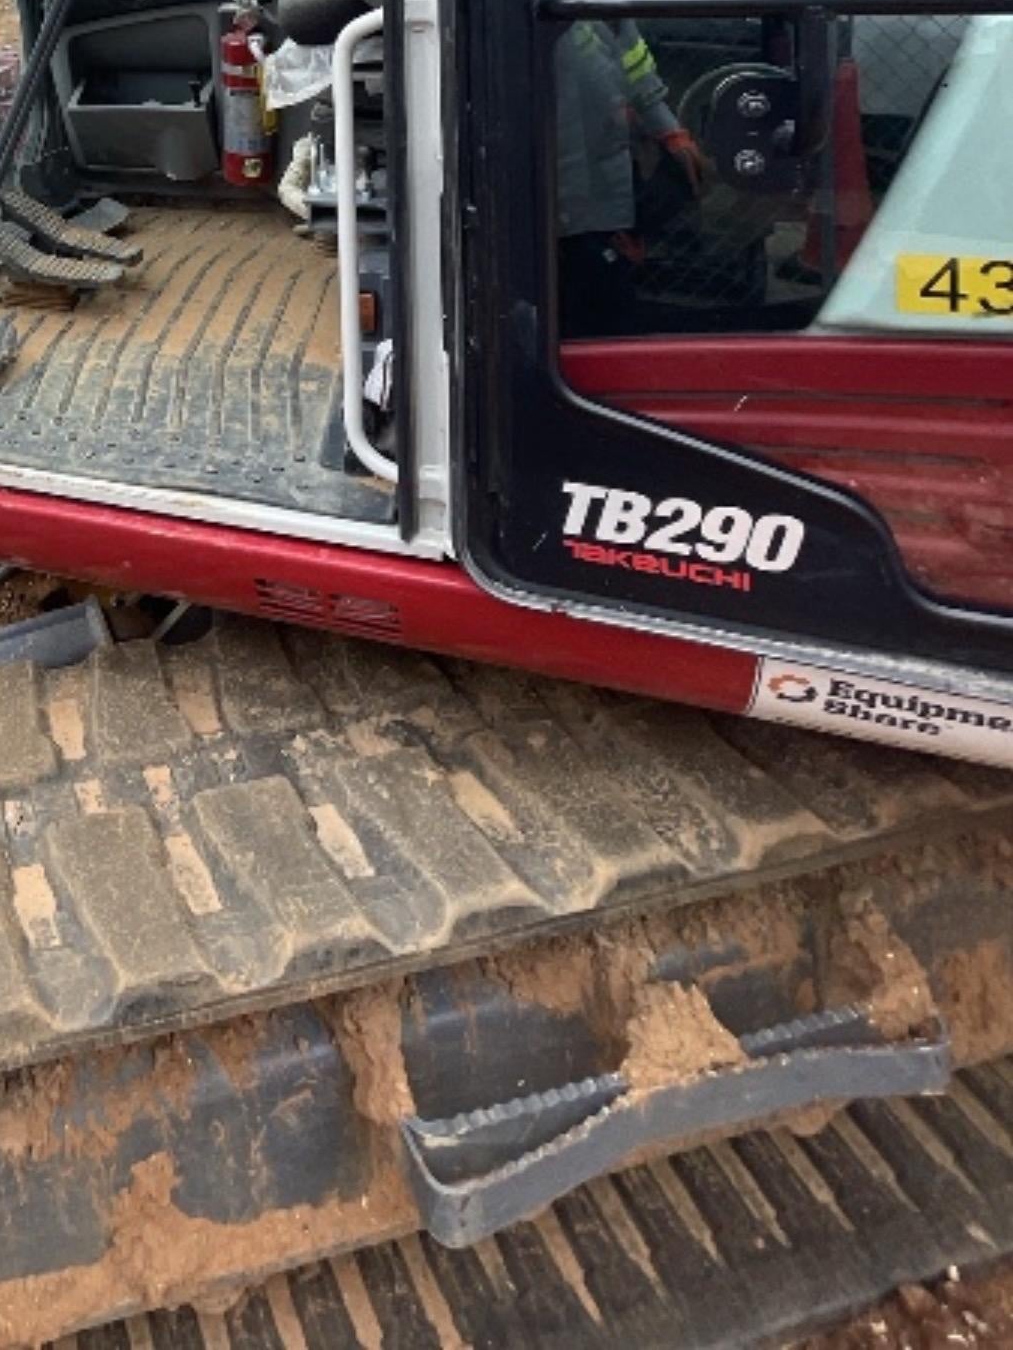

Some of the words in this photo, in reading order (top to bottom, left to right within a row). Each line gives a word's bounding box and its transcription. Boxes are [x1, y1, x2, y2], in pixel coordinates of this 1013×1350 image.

[920, 257, 1013, 315] 43
[562, 480, 805, 572] TB290
[823, 699, 940, 735] Share
